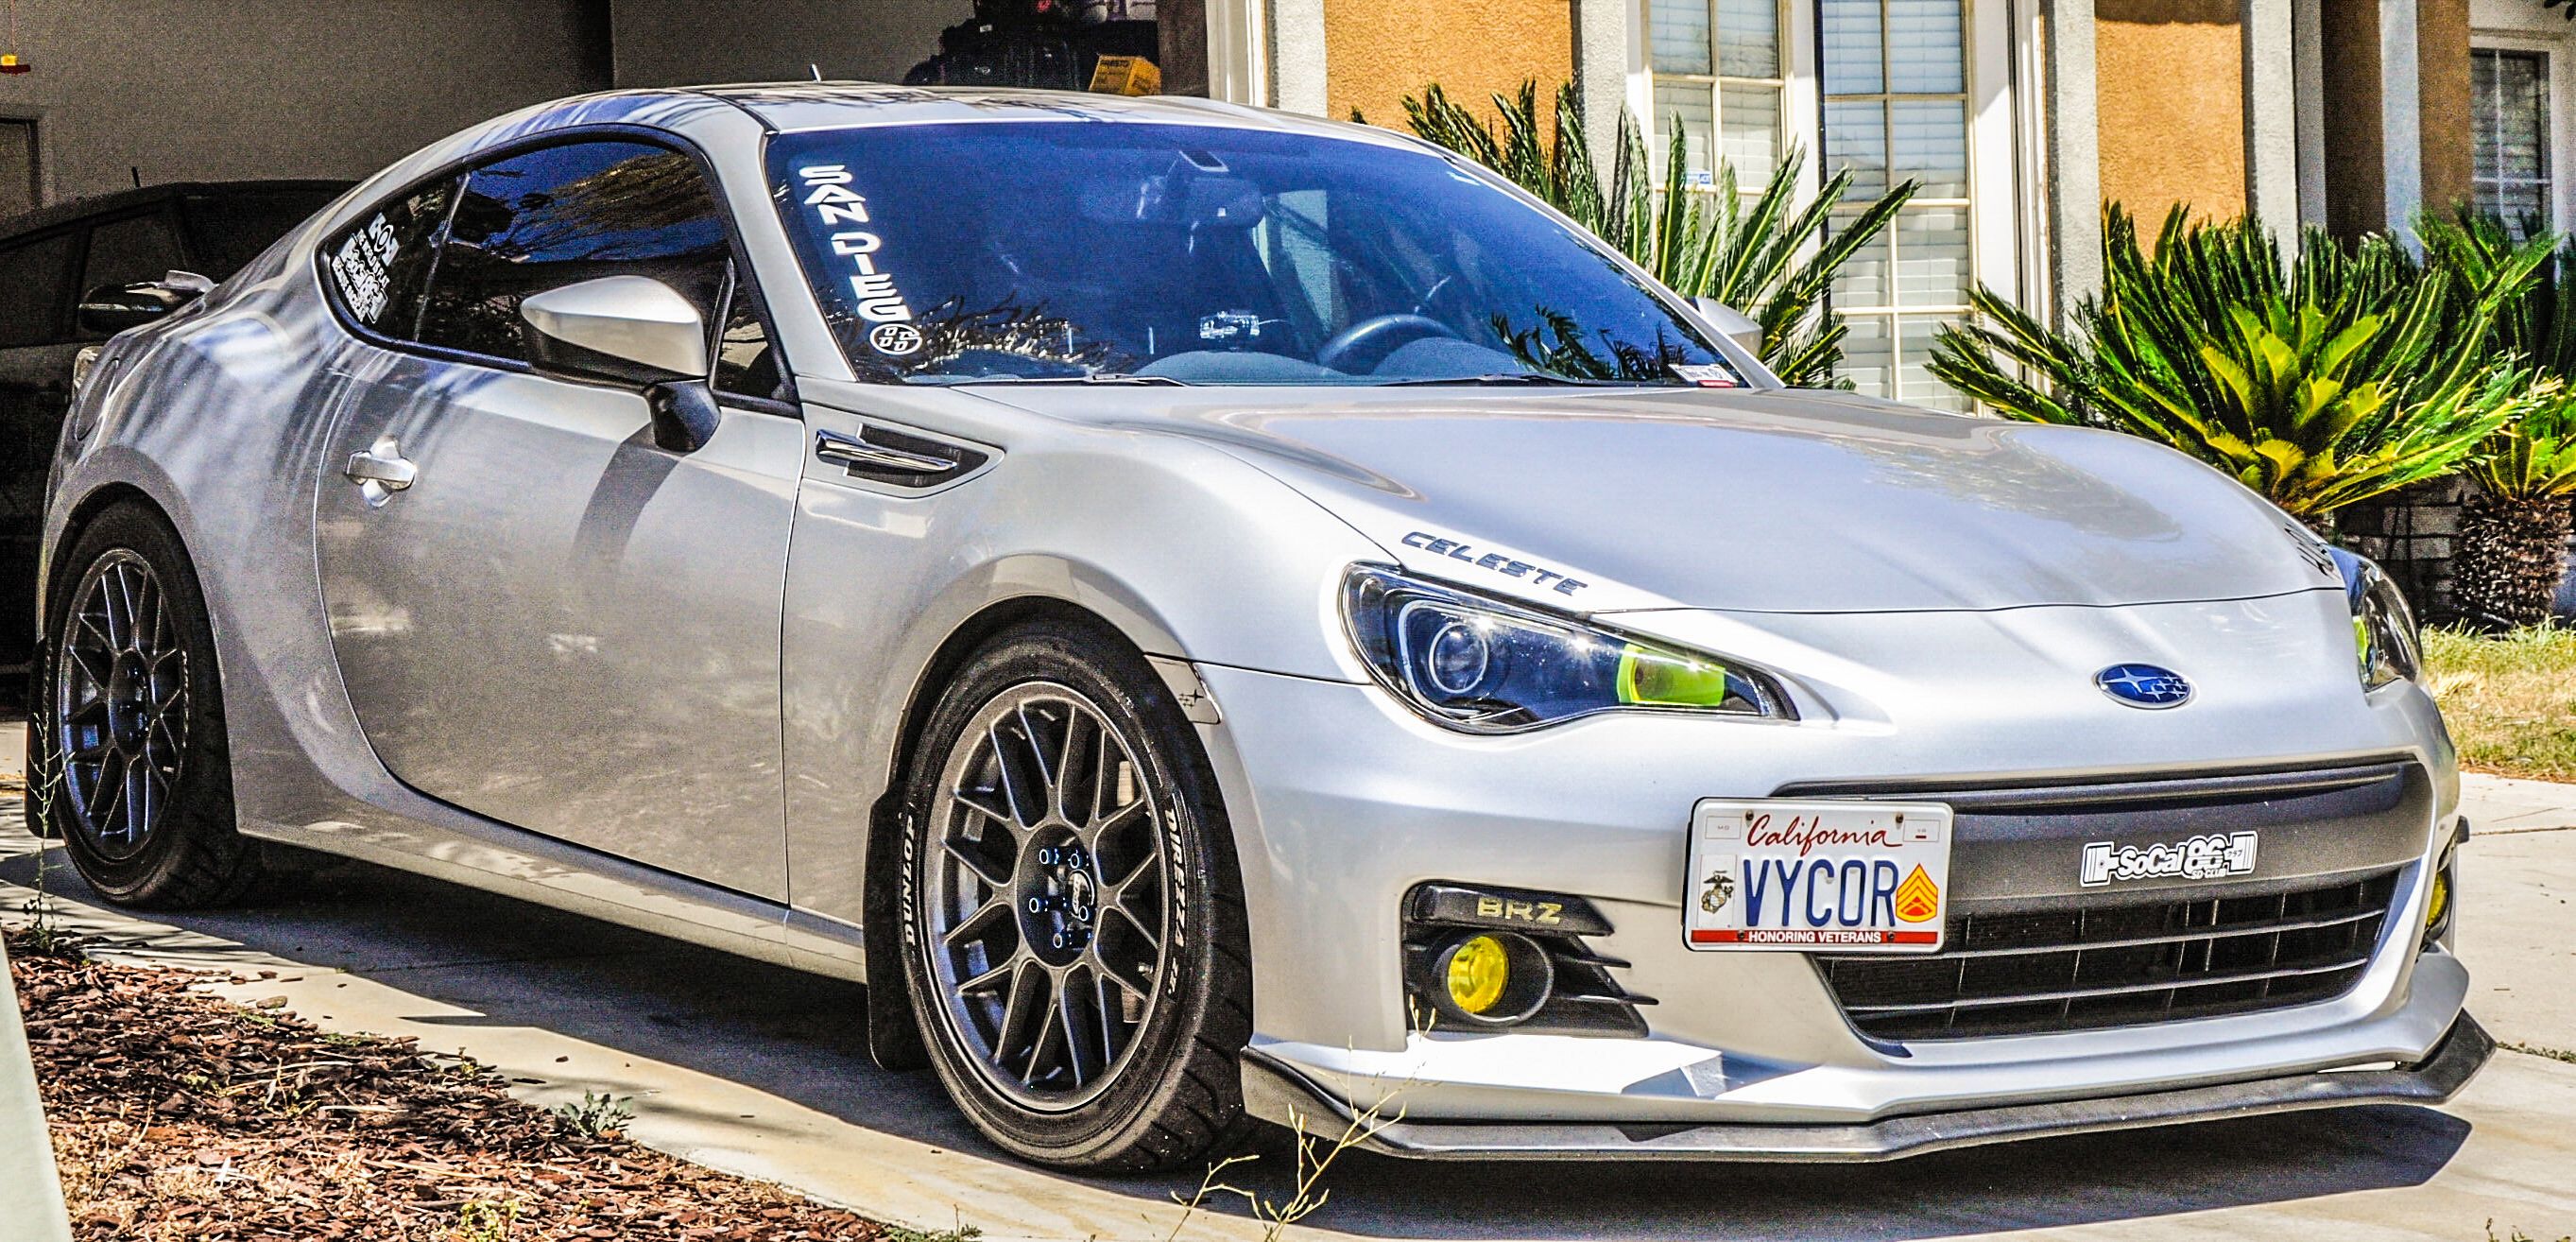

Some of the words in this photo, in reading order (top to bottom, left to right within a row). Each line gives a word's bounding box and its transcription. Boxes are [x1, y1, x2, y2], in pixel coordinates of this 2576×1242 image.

[799, 164, 869, 225] SAN
[1401, 531, 1588, 596] CELESTE
[1747, 814, 1902, 856] California
[2118, 845, 2186, 876] SoCal
[2183, 836, 2225, 871] 86
[902, 815, 916, 946] DUNLOP
[1164, 808, 1187, 947] DIREZZA
[1743, 859, 1899, 927] VYCOR
[1477, 897, 1563, 924] BRZ
[1748, 931, 1815, 943] HONORING
[1818, 931, 1881, 943] VETERANS
